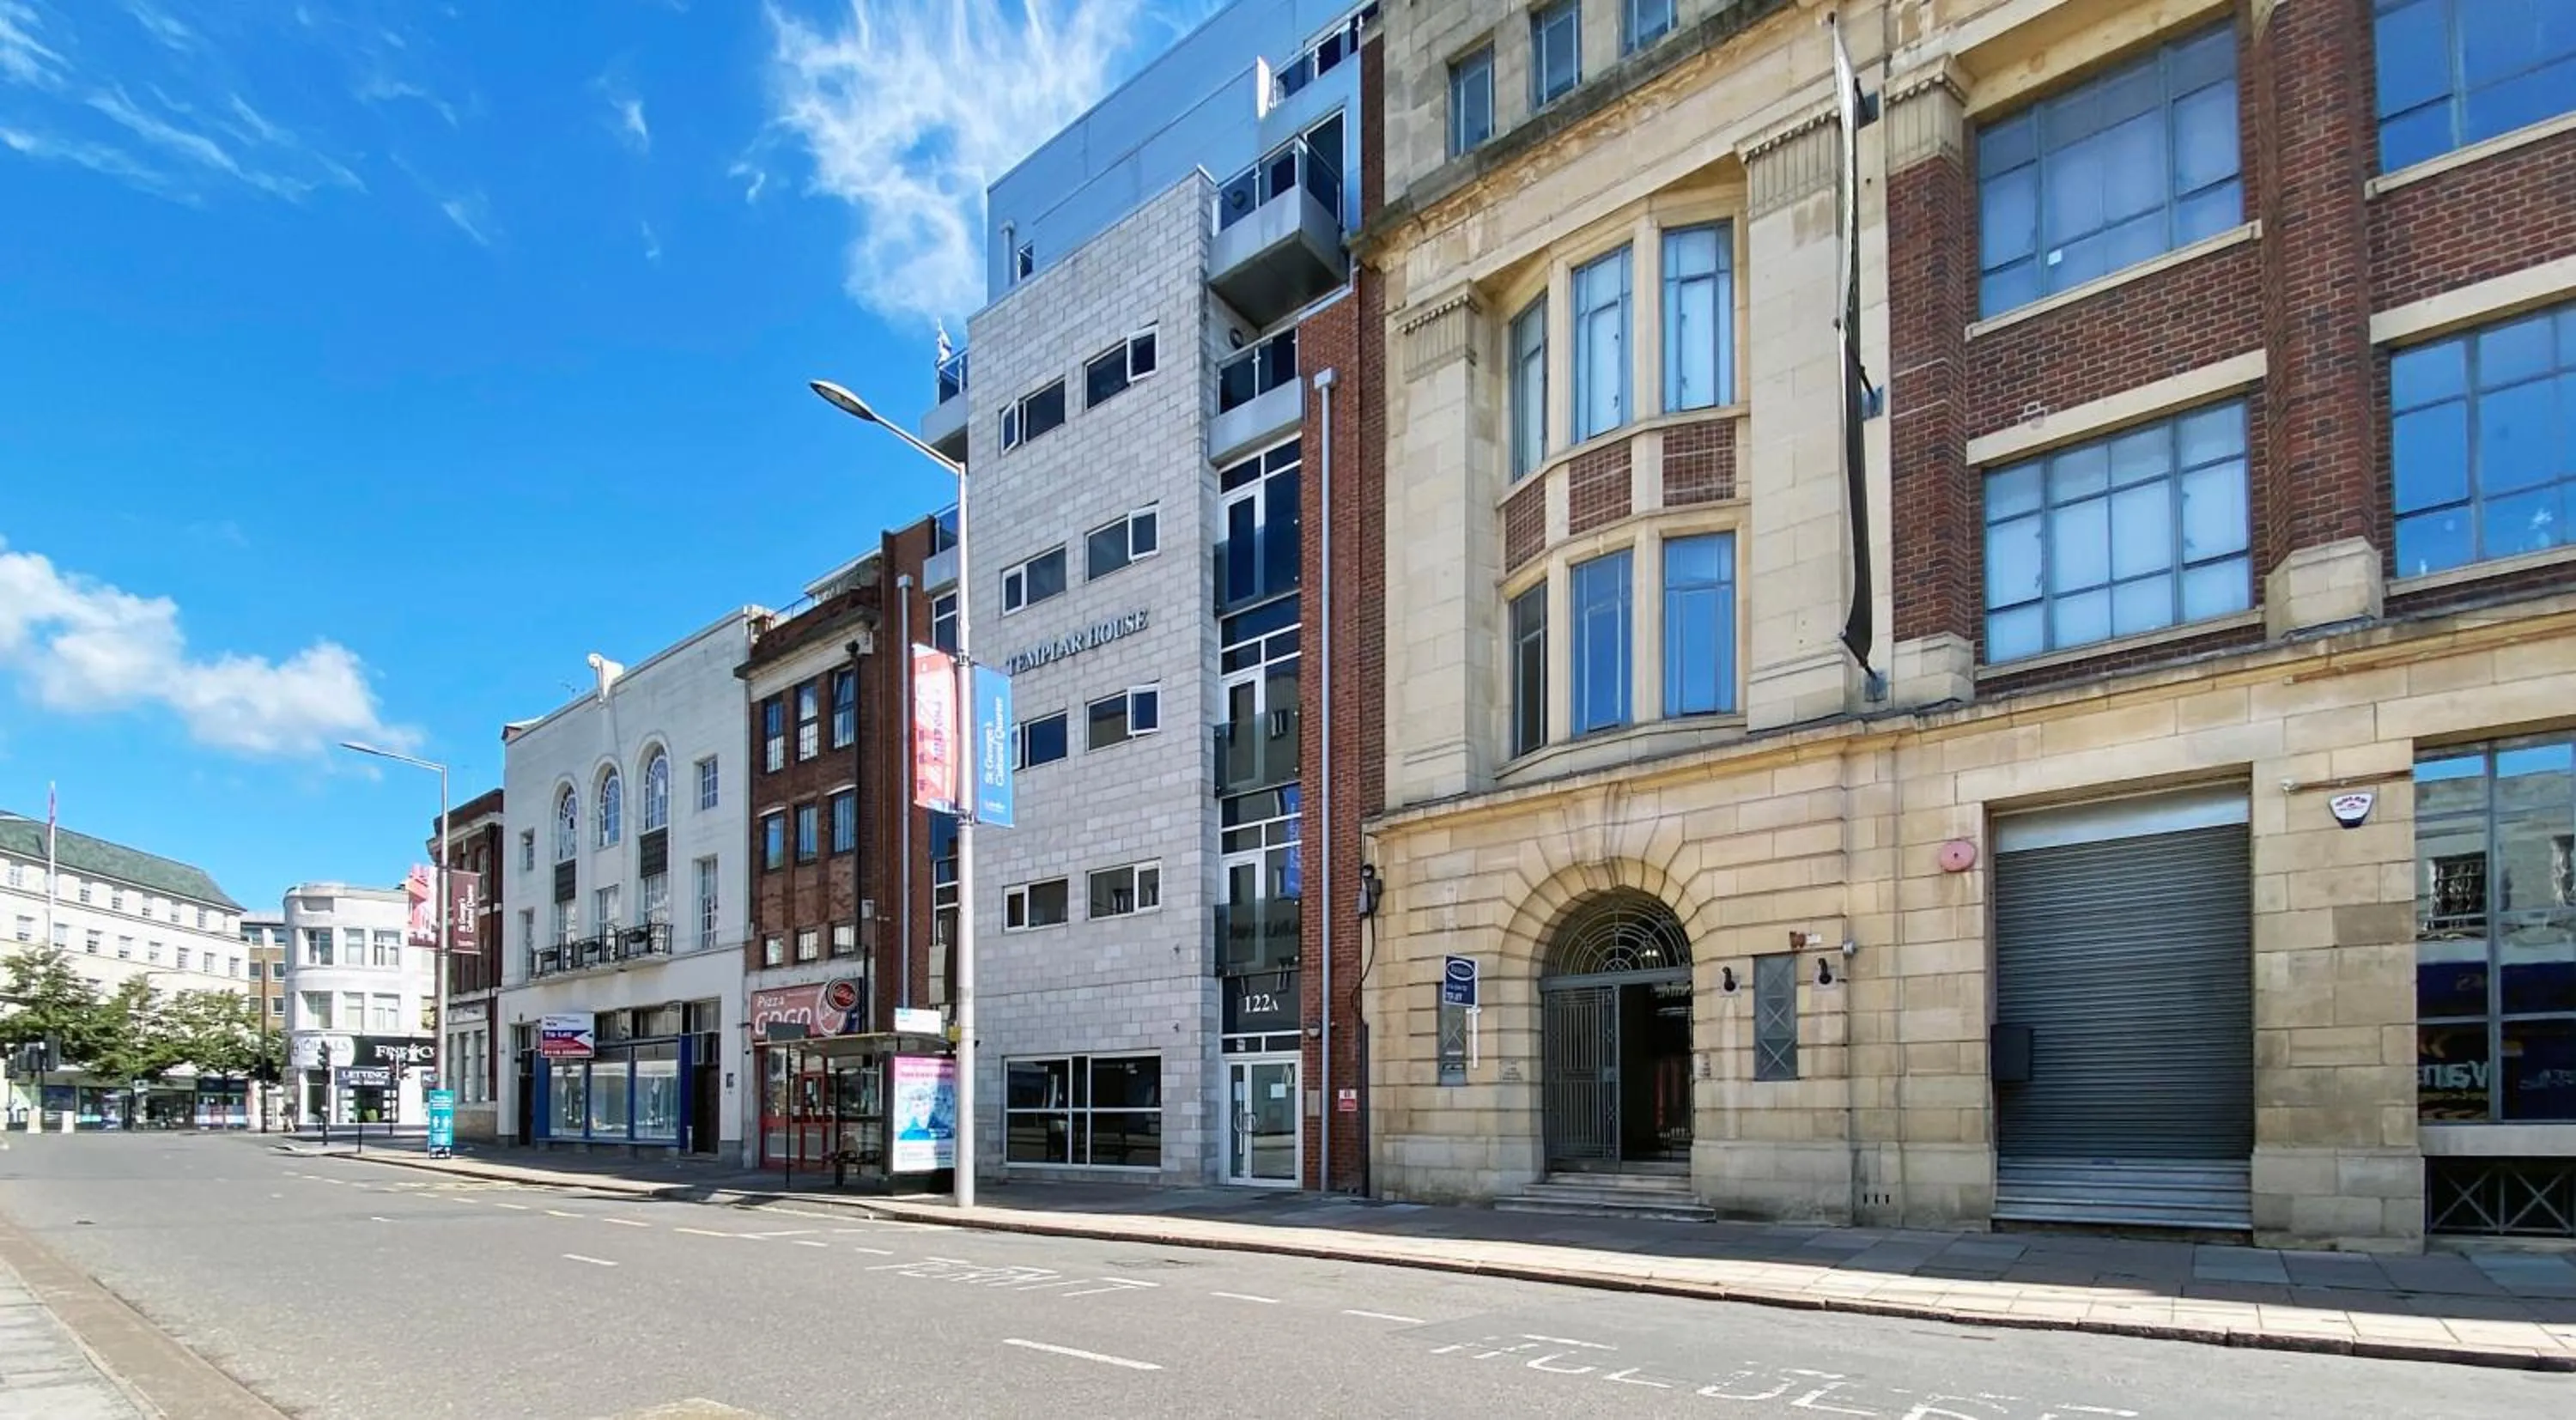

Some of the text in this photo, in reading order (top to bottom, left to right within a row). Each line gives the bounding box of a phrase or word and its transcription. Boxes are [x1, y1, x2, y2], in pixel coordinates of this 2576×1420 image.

[1006, 609, 1149, 677] TEMPLAR HOUSE
[757, 995, 785, 1008] Pizza
